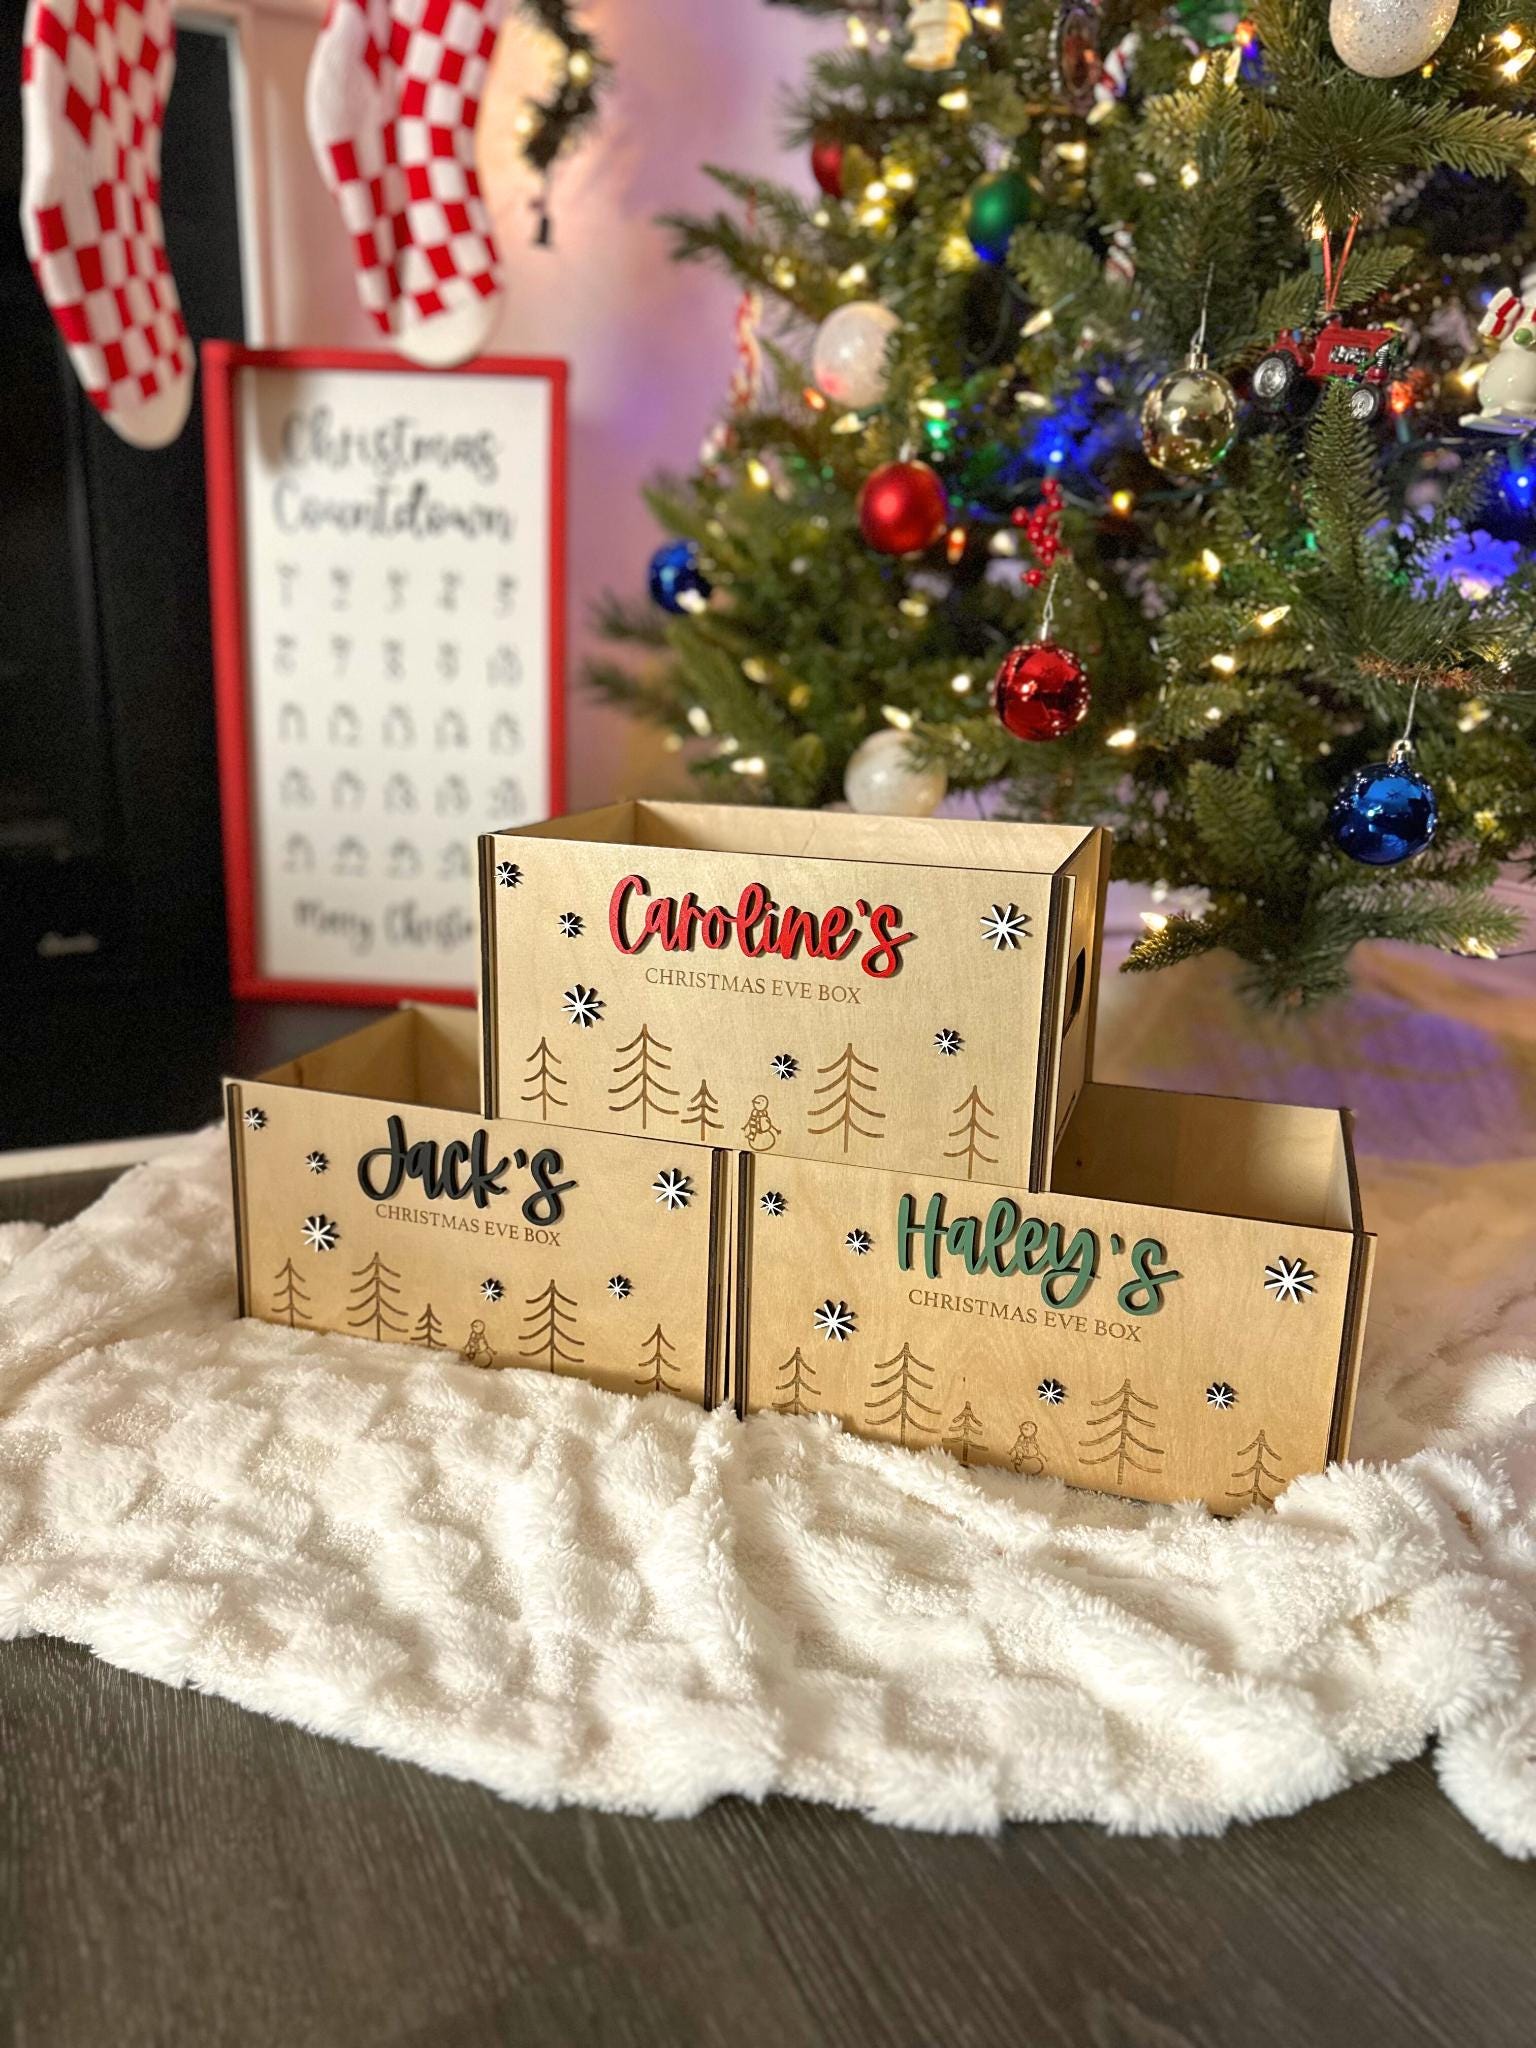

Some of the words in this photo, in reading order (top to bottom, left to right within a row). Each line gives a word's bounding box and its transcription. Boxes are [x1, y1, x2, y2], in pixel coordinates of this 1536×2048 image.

[281, 402, 500, 485] Christmas
[271, 475, 516, 543] Countdown
[608, 874, 915, 979] Caroline's
[645, 967, 767, 995] CHRISTMAS
[771, 980, 813, 1000] EVE
[818, 985, 862, 1005] BOX
[357, 1114, 577, 1227] Jack's
[375, 1203, 480, 1233] CHRISTMAS
[484, 1220, 520, 1240] EVE
[523, 1227, 562, 1247] BOX
[897, 1192, 1182, 1317] Haley's
[908, 1288, 1038, 1325] CHRISTMAS
[1044, 1310, 1088, 1334] EVE
[1094, 1319, 1142, 1344] BOX
